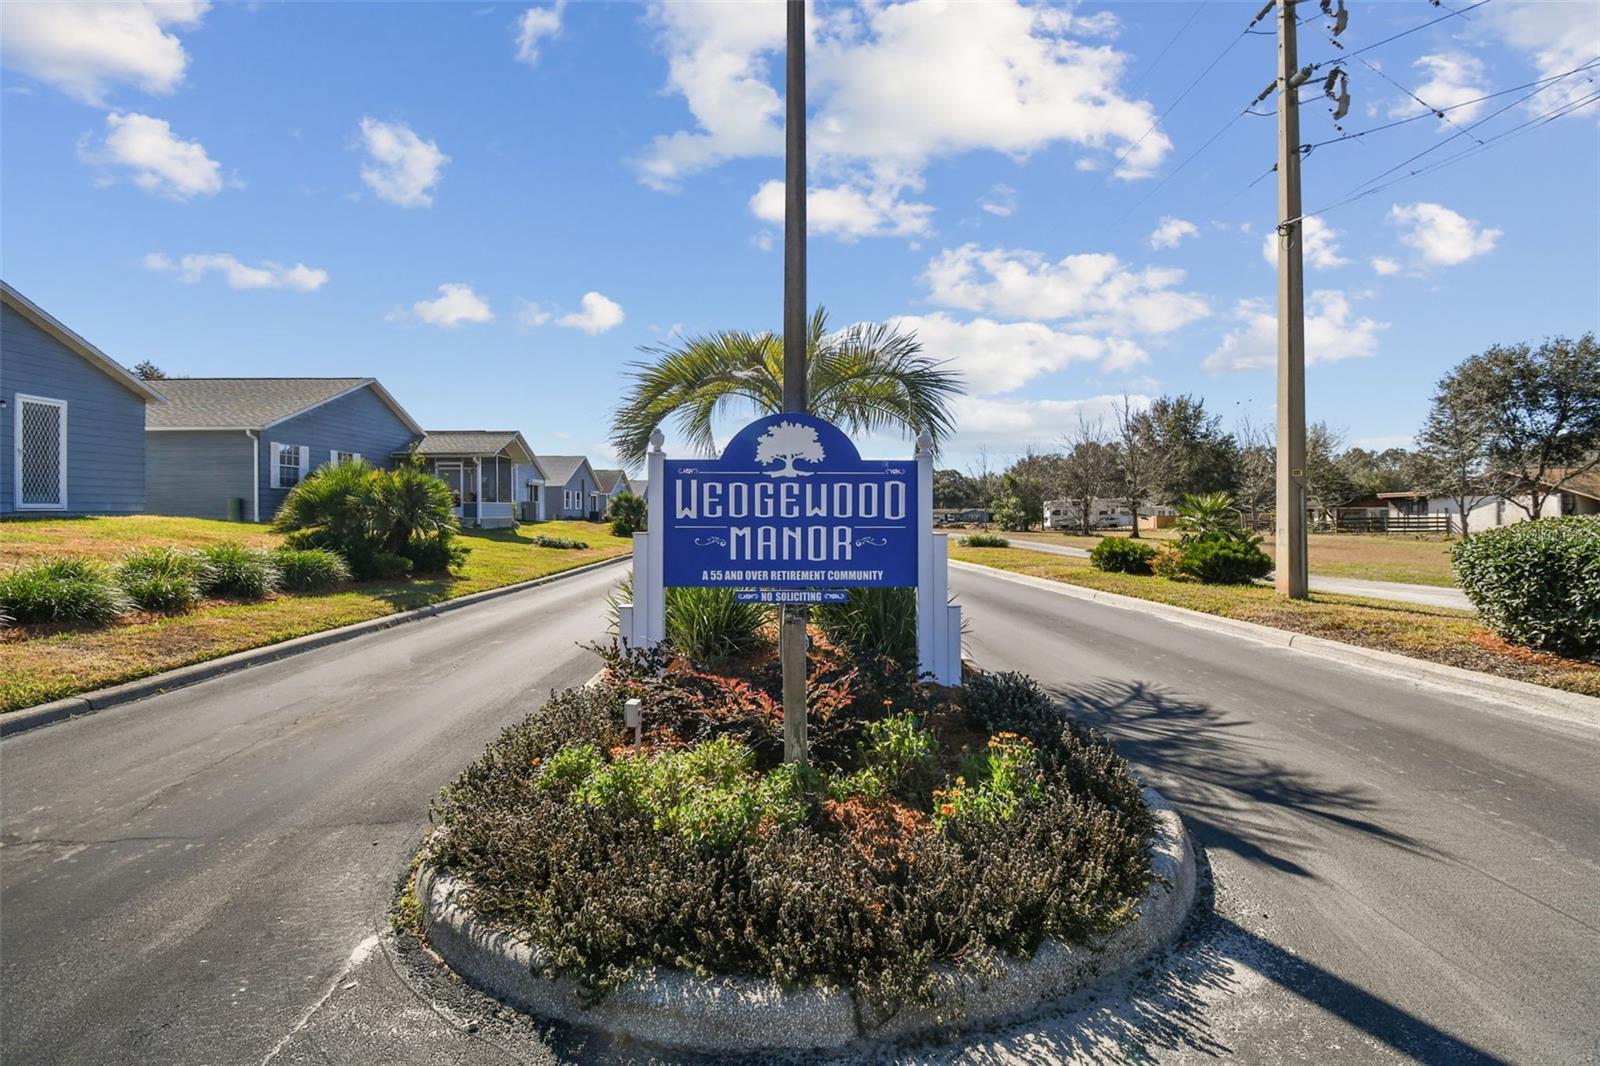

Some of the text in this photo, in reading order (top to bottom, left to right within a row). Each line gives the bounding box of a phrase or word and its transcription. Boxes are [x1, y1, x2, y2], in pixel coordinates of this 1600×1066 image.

[675, 479, 906, 520] WEDGEWOOD
[730, 525, 852, 562] MANOR
[702, 570, 883, 581] A 55 AND OVER RETIREMENT COMMUNITY
[761, 591, 822, 602] NO SOLICITING
